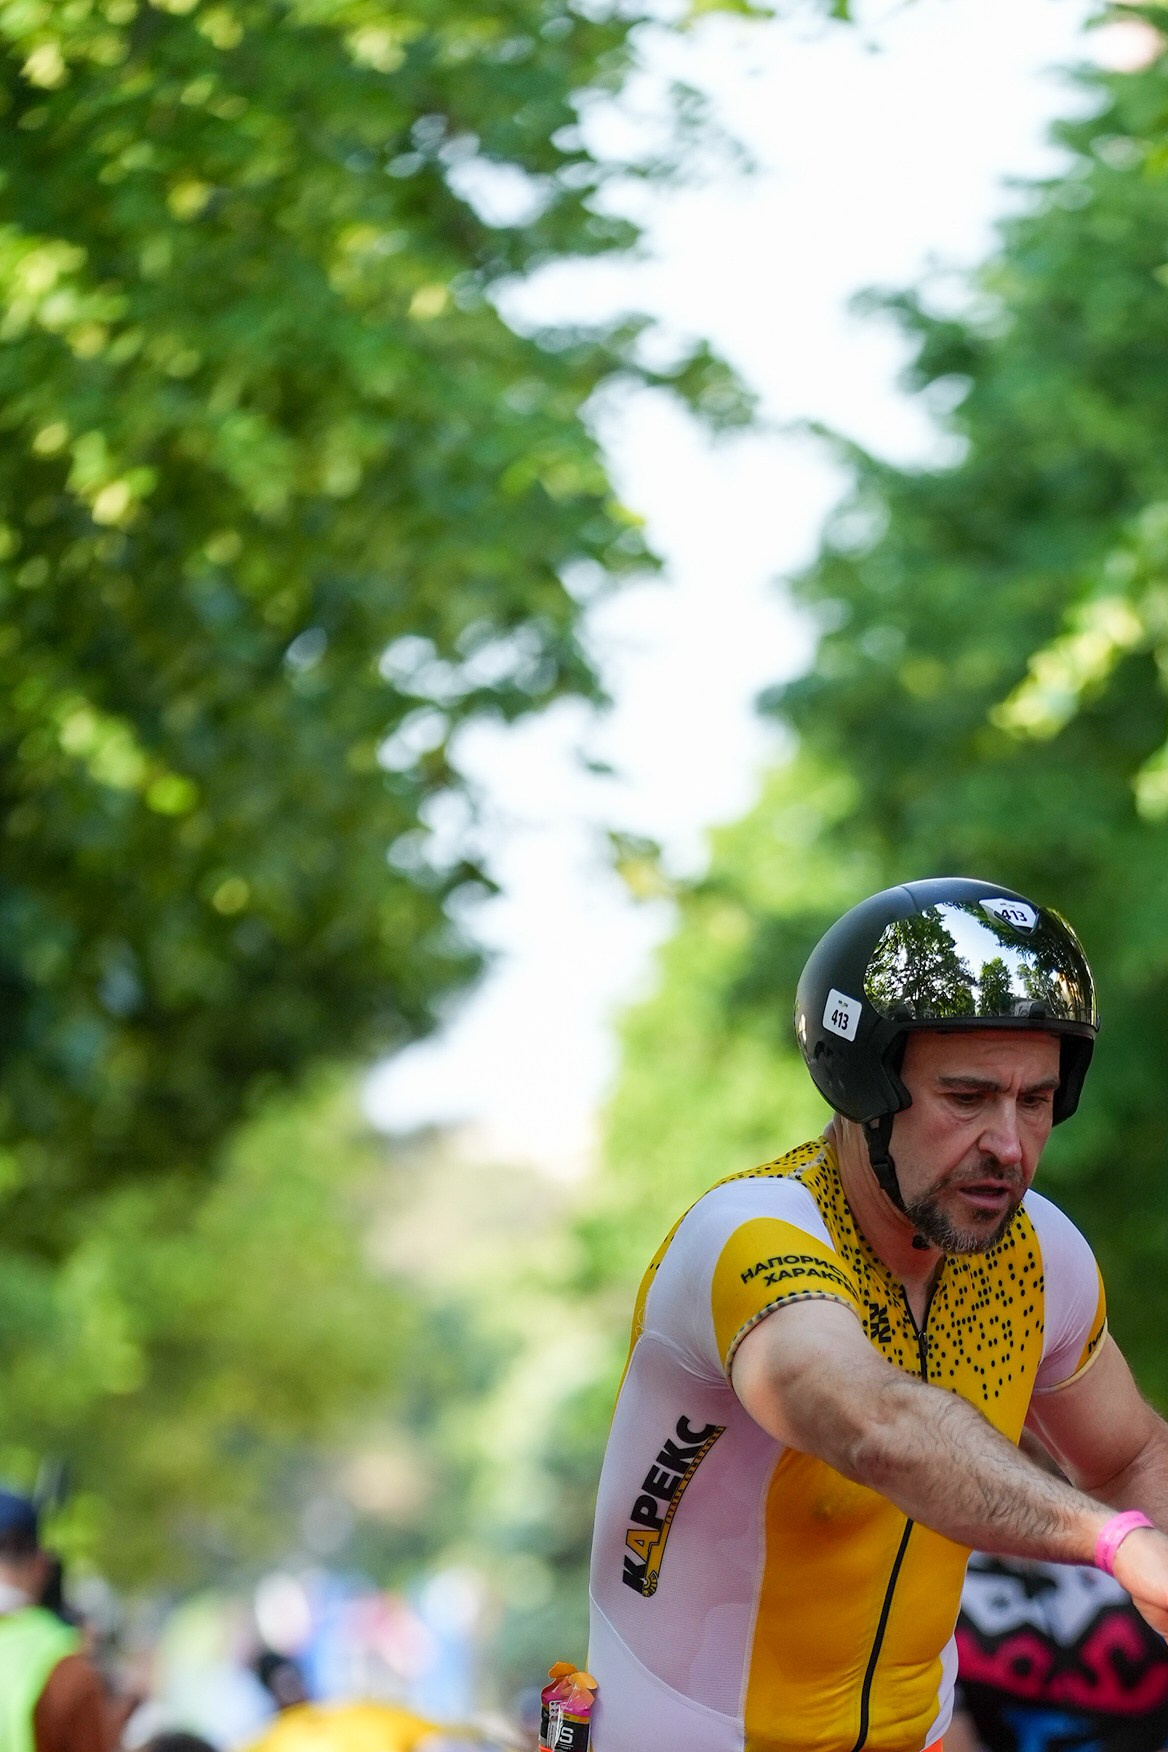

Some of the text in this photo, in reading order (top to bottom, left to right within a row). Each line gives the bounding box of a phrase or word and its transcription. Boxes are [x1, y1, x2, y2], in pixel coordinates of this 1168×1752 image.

[1001, 909, 1028, 922] 413
[831, 1009, 849, 1031] 413
[763, 1268, 850, 1294] ХАРАКТ
[622, 1415, 717, 1596] КАРЕКС
